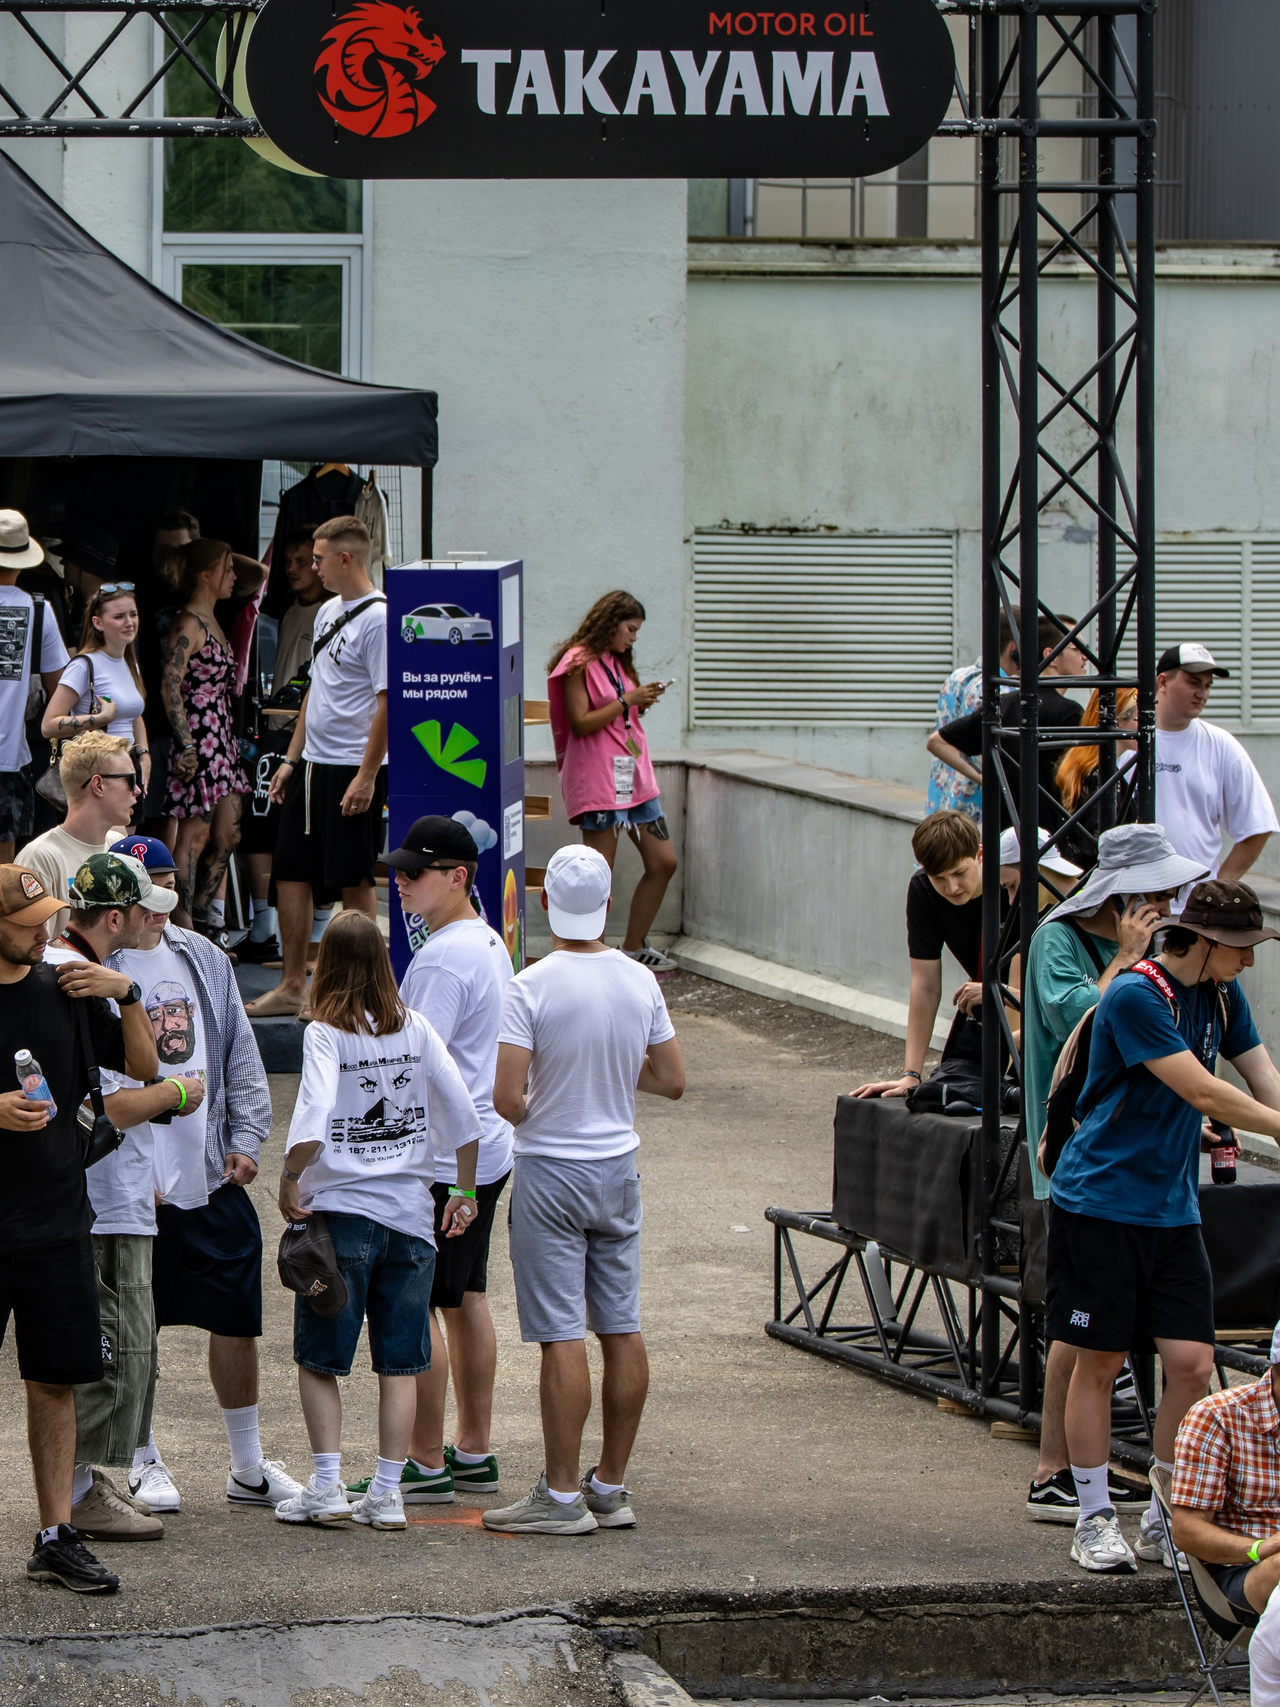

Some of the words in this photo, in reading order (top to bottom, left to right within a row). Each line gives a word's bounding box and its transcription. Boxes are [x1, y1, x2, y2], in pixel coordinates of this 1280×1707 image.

[709, 12, 817, 36] MOTOR
[824, 13, 874, 36] OIL
[461, 49, 890, 116] TAKAYAMA
[402, 672, 421, 682] Вы
[423, 674, 438, 682] за
[440, 672, 481, 685] рулём
[402, 689, 423, 698] мы
[425, 689, 468, 701] рядом
